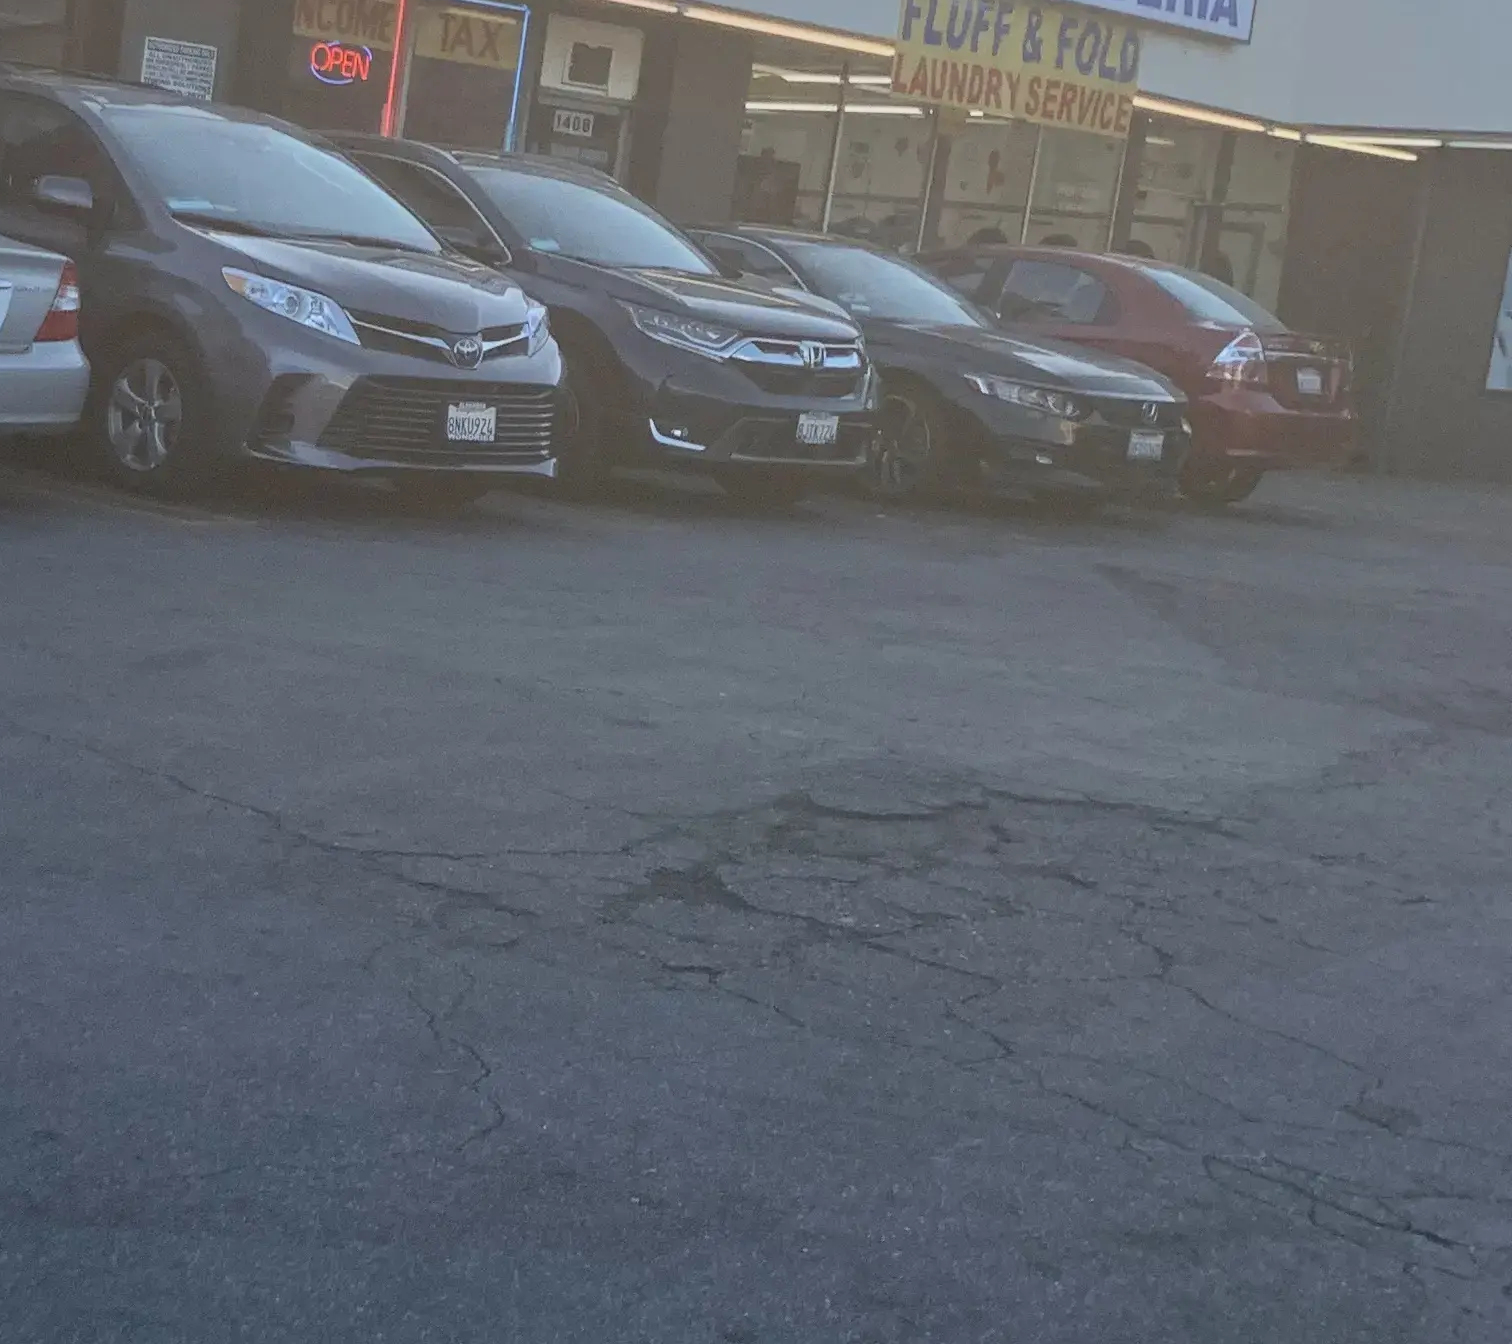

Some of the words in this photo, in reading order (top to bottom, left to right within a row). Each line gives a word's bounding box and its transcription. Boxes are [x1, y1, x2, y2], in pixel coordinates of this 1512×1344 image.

[310, 42, 370, 81] OPEN
[438, 11, 505, 63] TAX
[1022, 5, 1044, 65] &
[1054, 12, 1142, 84] FOLD
[890, 52, 1022, 113] LAUNDRY
[1024, 74, 1134, 134] SERVICE
